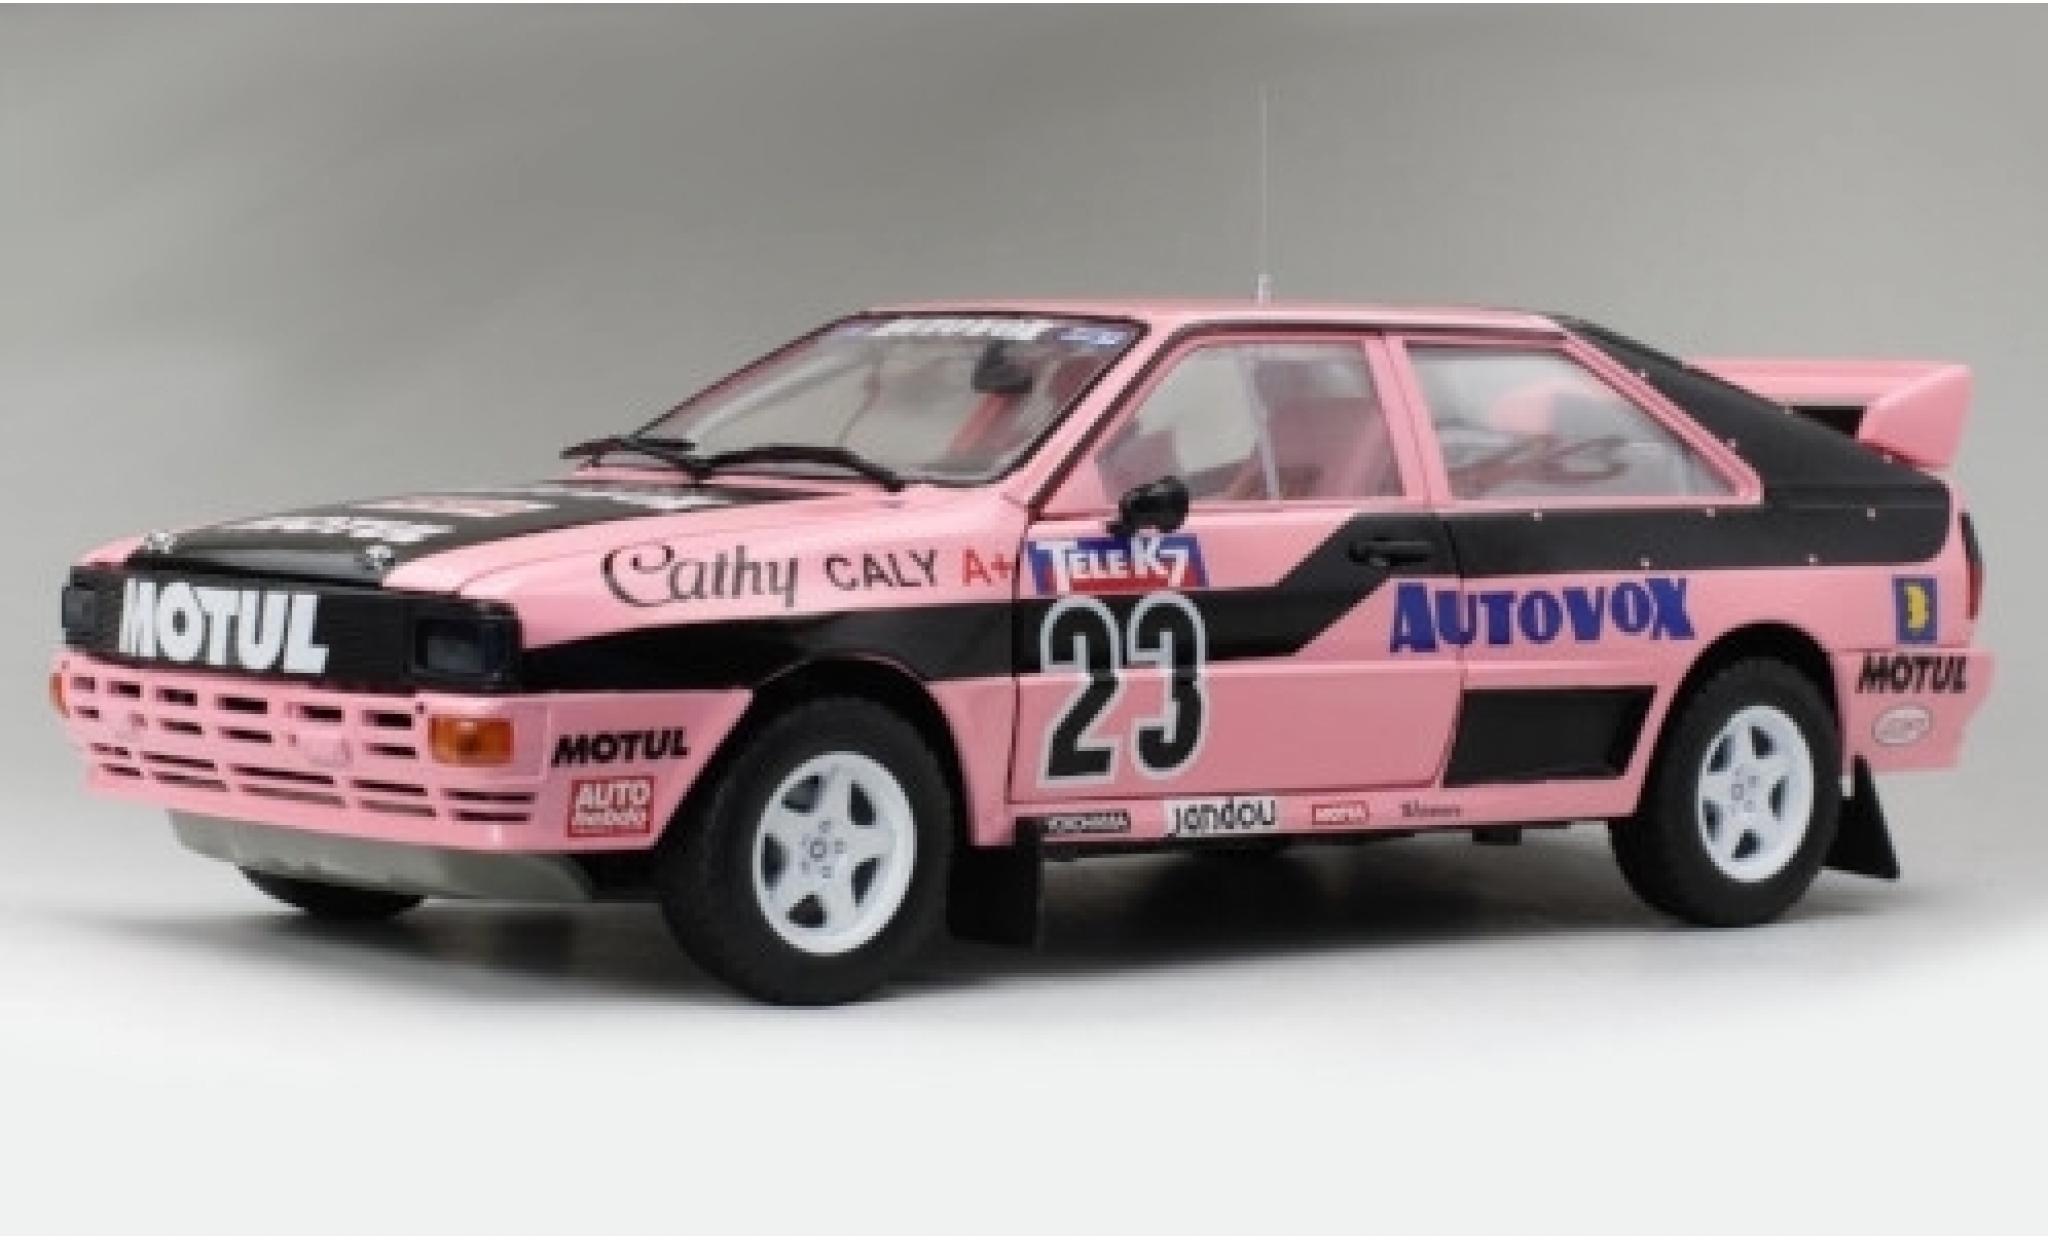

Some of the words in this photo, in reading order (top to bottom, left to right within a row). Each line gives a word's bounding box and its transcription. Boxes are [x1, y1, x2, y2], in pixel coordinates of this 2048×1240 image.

[601, 544, 798, 607] Cathy
[823, 549, 937, 591] CALY
[119, 580, 329, 674] MOTUL
[1388, 577, 1697, 653] AUTOVOX
[1037, 593, 1210, 788] 23
[1855, 653, 1967, 694] MOTUL
[551, 727, 690, 767] MOTUL
[576, 780, 650, 808] AUTO
